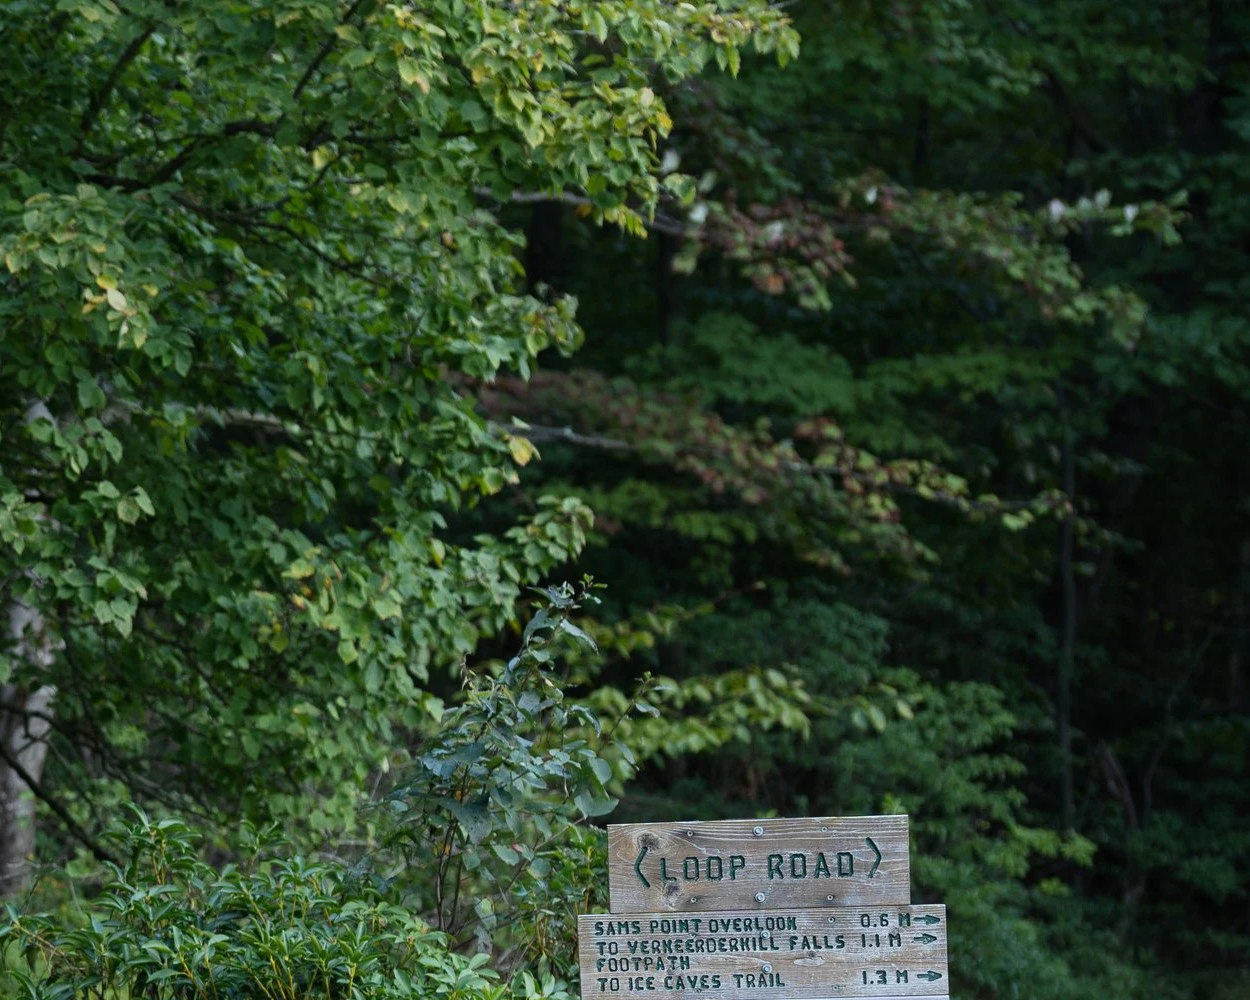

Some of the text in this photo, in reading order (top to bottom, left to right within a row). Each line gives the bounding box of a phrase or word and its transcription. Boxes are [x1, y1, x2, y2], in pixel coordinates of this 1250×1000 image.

[659, 852, 854, 883] LOOP ROAD
[595, 917, 797, 935] SAMS POINT OVERLOOK
[861, 914, 889, 927] 0.6
[596, 941, 617, 955] TO
[790, 935, 845, 950] FALLS
[861, 934, 880, 948] 1.1
[597, 956, 690, 972] FOOTPATH
[597, 973, 785, 992] TO ICE CAVES TRAIL
[862, 970, 887, 984] 1.3
